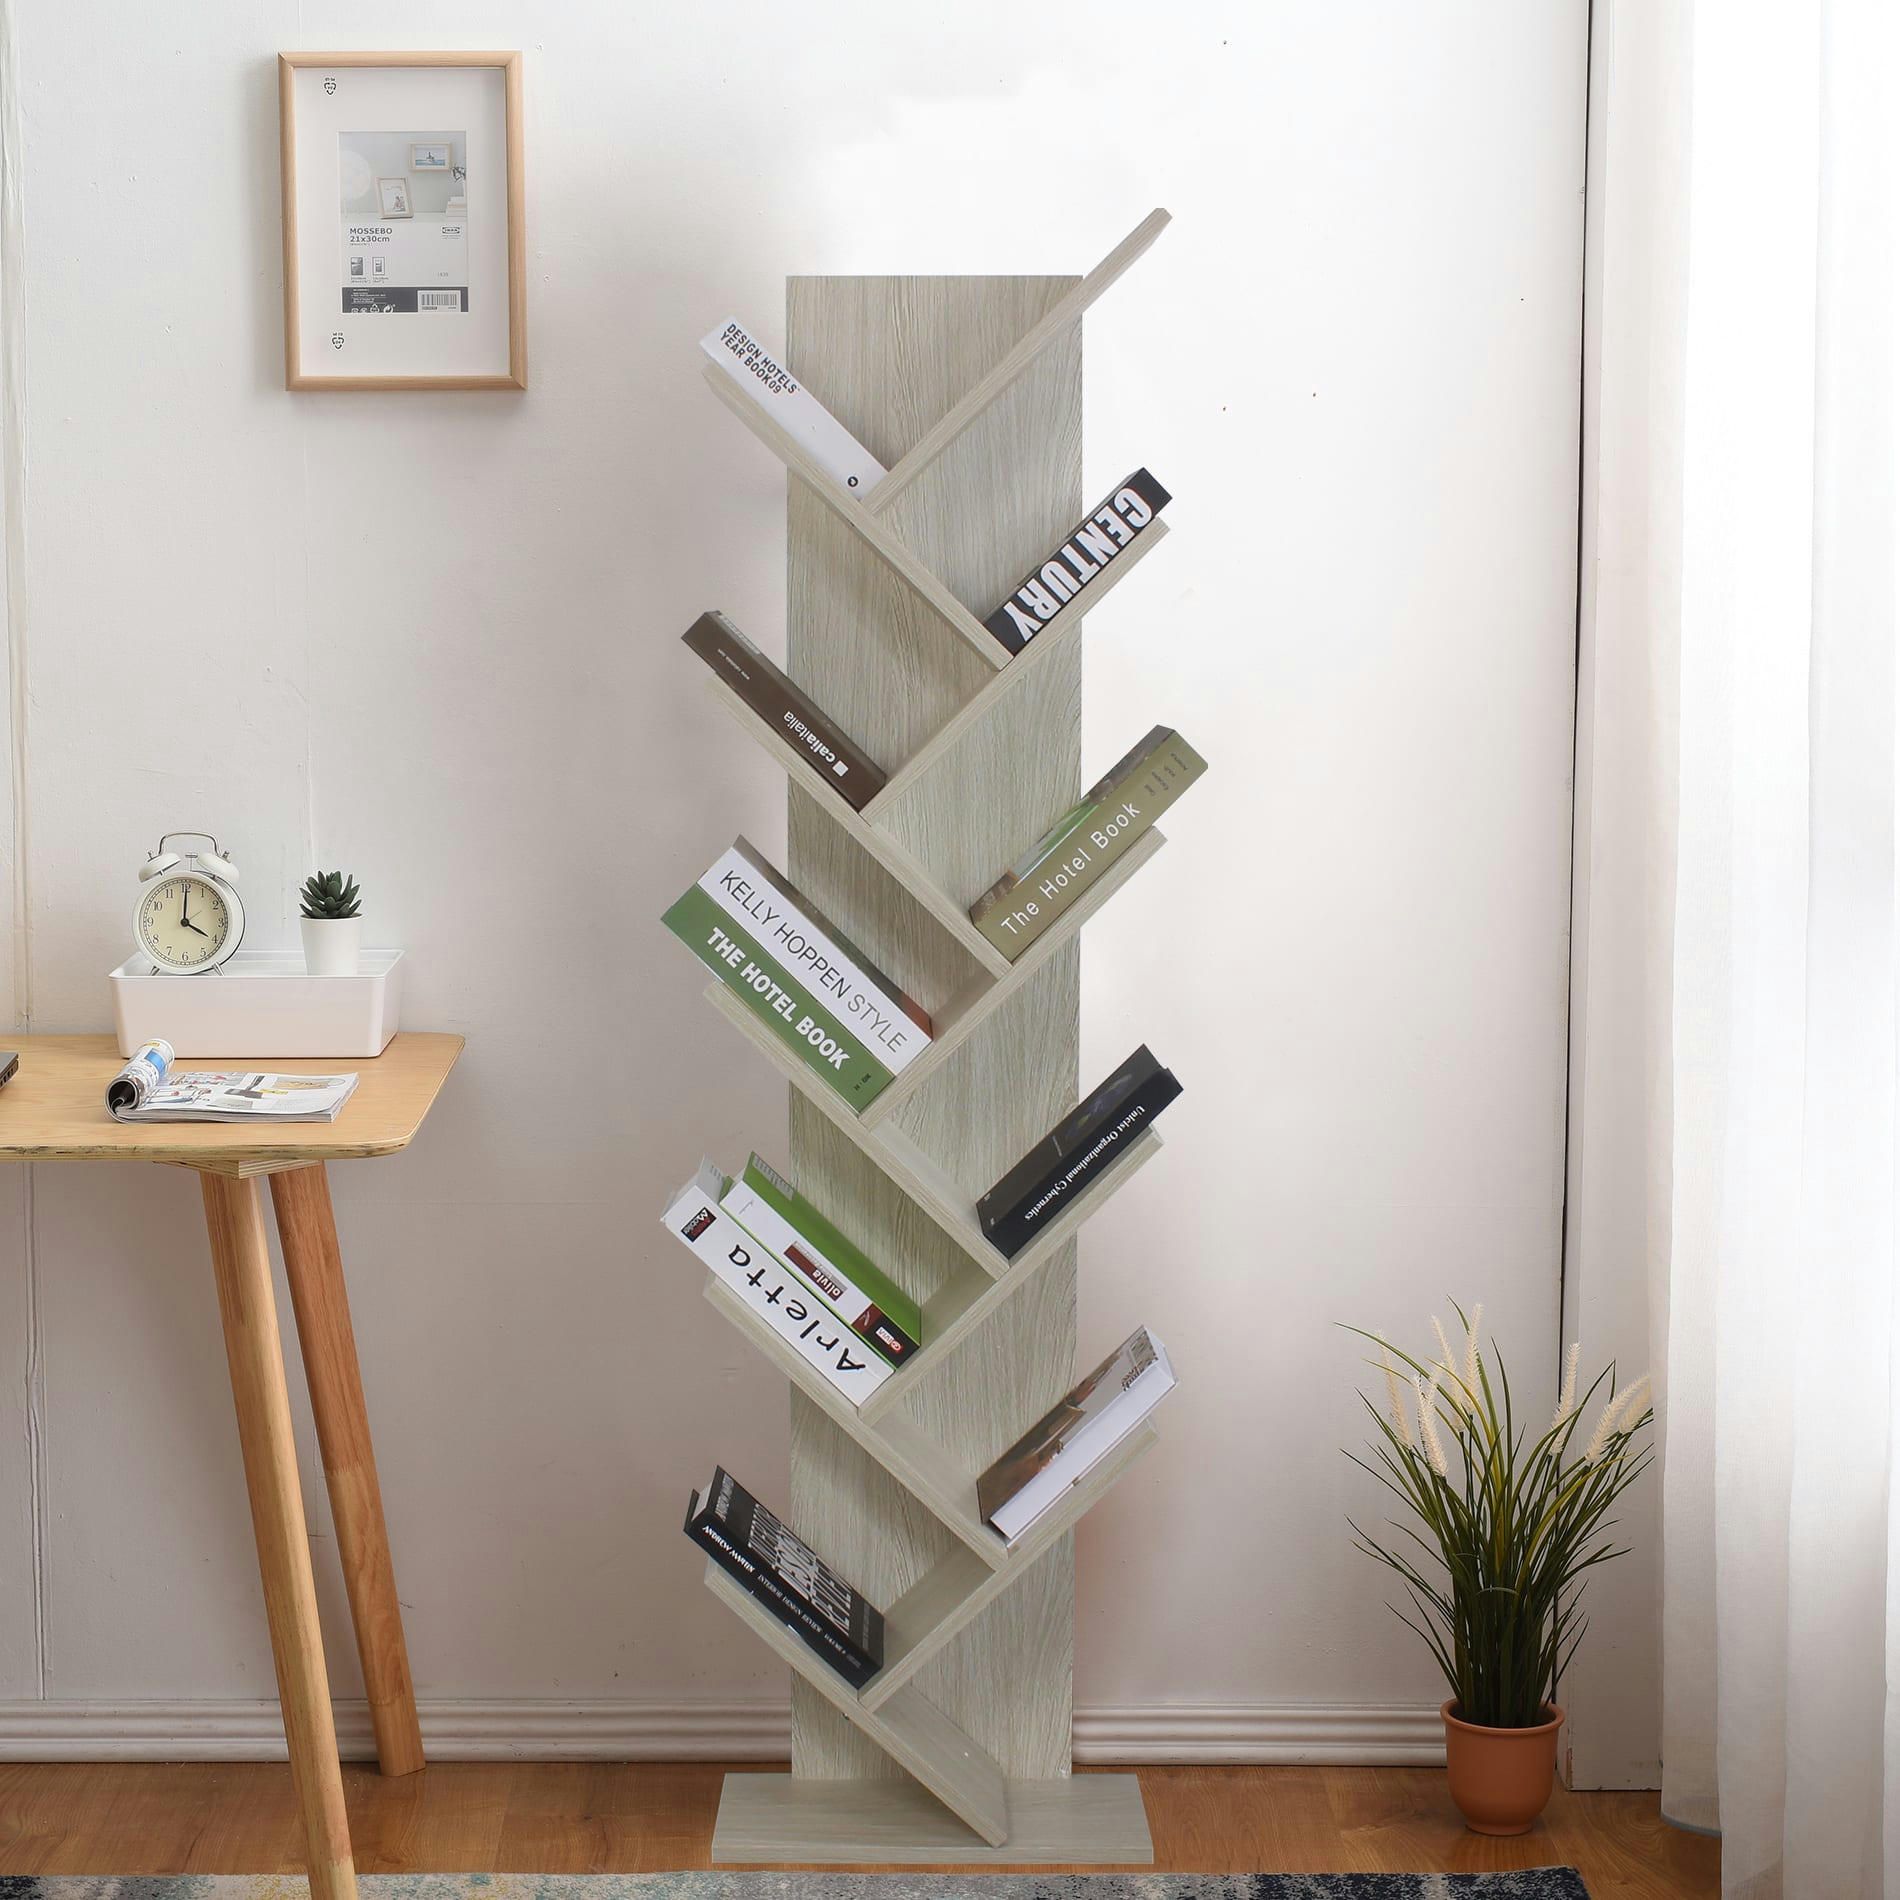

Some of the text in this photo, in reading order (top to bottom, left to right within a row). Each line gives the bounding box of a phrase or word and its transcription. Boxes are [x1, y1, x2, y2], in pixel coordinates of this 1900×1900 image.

[349, 227, 393, 235] MOSSEBO
[349, 235, 391, 243] 21x30cm
[720, 331, 782, 394] YEAR BOOK09
[726, 323, 798, 394] DESIGN HOTELS
[1003, 487, 1152, 642] CENTURY
[1000, 802, 1141, 936] The Hotel Book
[165, 889, 173, 899] 11
[200, 888, 205, 898] 1
[153, 901, 163, 911] 10
[212, 901, 219, 910] 2
[147, 917, 154, 927] 9
[218, 918, 224, 928] 3
[153, 934, 159, 944] 8
[211, 934, 219, 944] 4
[166, 946, 172, 956] 7
[182, 951, 189, 961] 6
[200, 947, 206, 957] 5
[719, 869, 908, 1053] KELLY HOPPEN STYLE
[706, 926, 851, 1071] THE HOTEL BOOK
[1117, 1105, 1146, 1133] Unicist
[1065, 1130, 1119, 1184] Organizational
[1024, 1181, 1068, 1222] Cybernetics
[811, 1268, 842, 1298] olivia
[728, 1244, 866, 1372] Arletta
[702, 1524, 732, 1552] ANDREW
[729, 1549, 756, 1574] MARTIN
